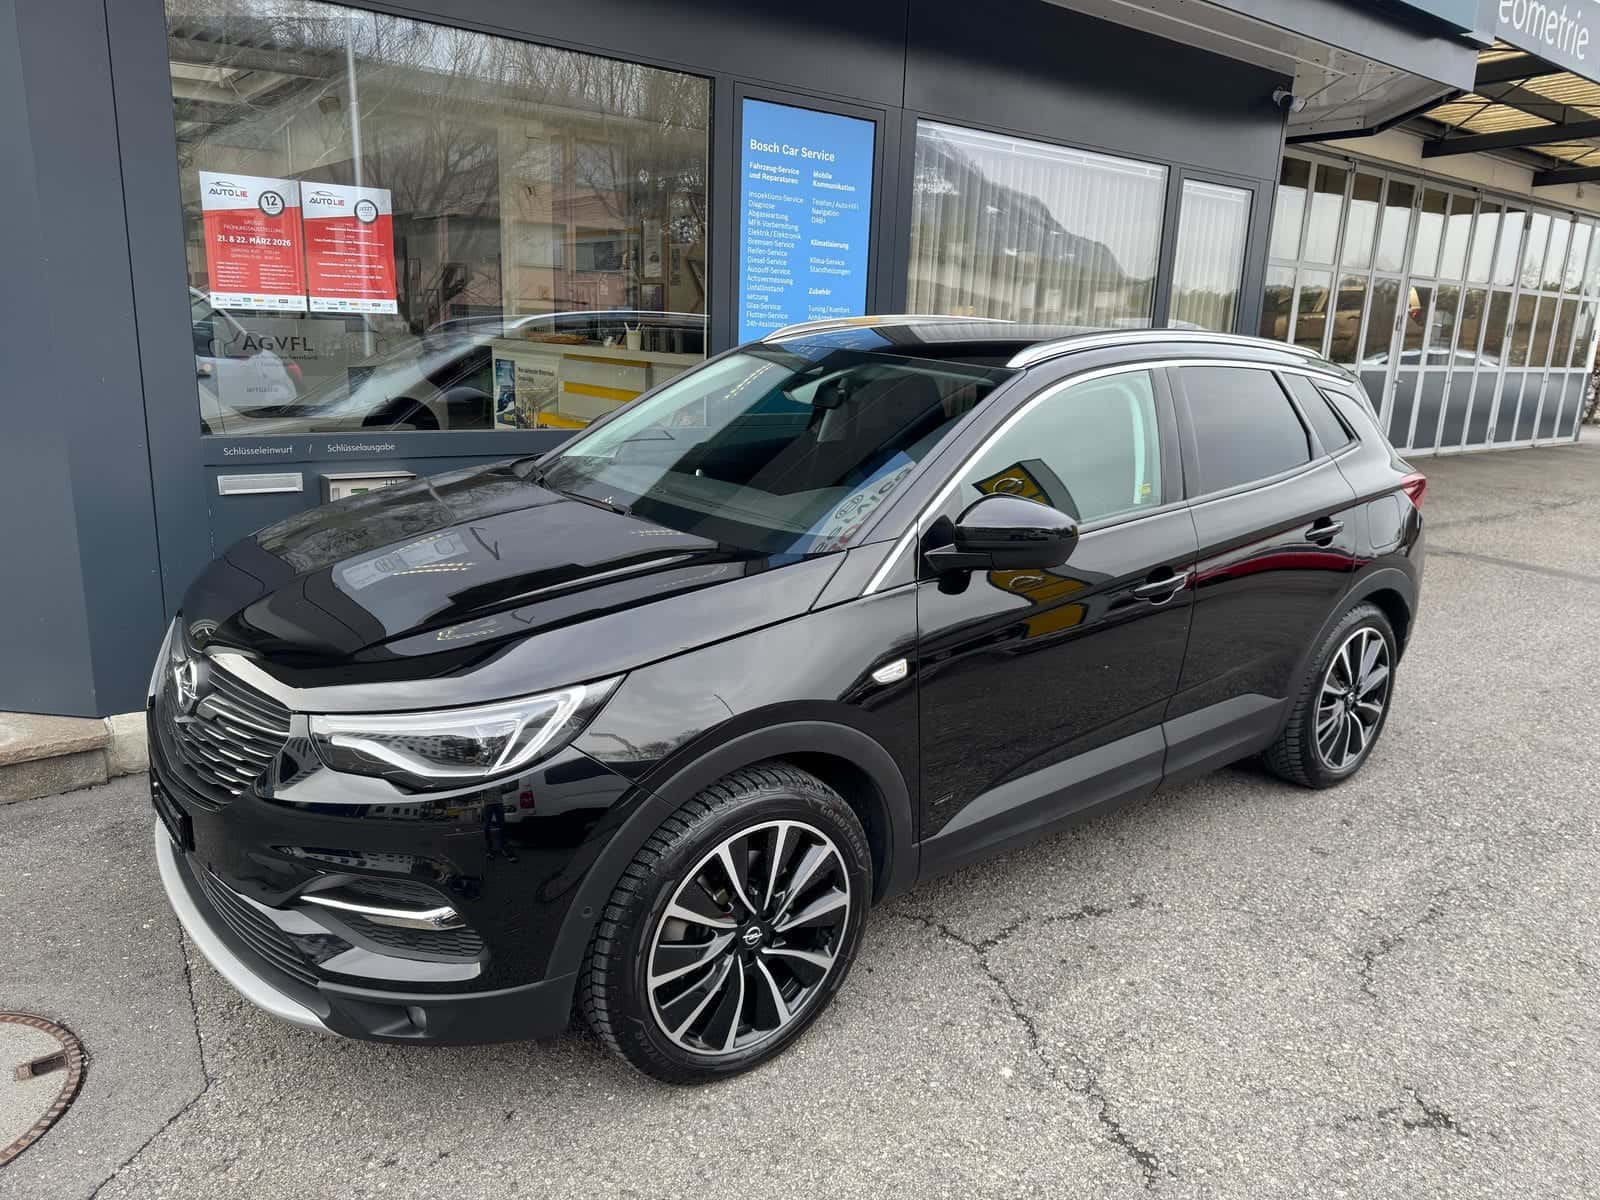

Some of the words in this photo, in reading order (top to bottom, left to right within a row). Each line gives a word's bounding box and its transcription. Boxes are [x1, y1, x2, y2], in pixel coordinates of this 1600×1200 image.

[750, 139, 780, 153] Bosch
[782, 144, 799, 157] Car
[801, 147, 835, 162] Service
[749, 171, 761, 179] und
[762, 173, 800, 185] Reparaturen
[813, 168, 833, 180] Mobile
[812, 180, 856, 192] Kommunikation
[264, 195, 278, 206] 12
[748, 200, 776, 210] Diagnose
[811, 207, 840, 218] Navigation
[217, 234, 228, 242] 21.
[236, 236, 248, 244] 22.
[249, 235, 271, 245] MÄRZ
[272, 238, 292, 247] 2026
[242, 335, 314, 352] AGVFL
[223, 445, 293, 457] Schlüsseleinwurf
[327, 442, 396, 454] Schlüsselausgabe
